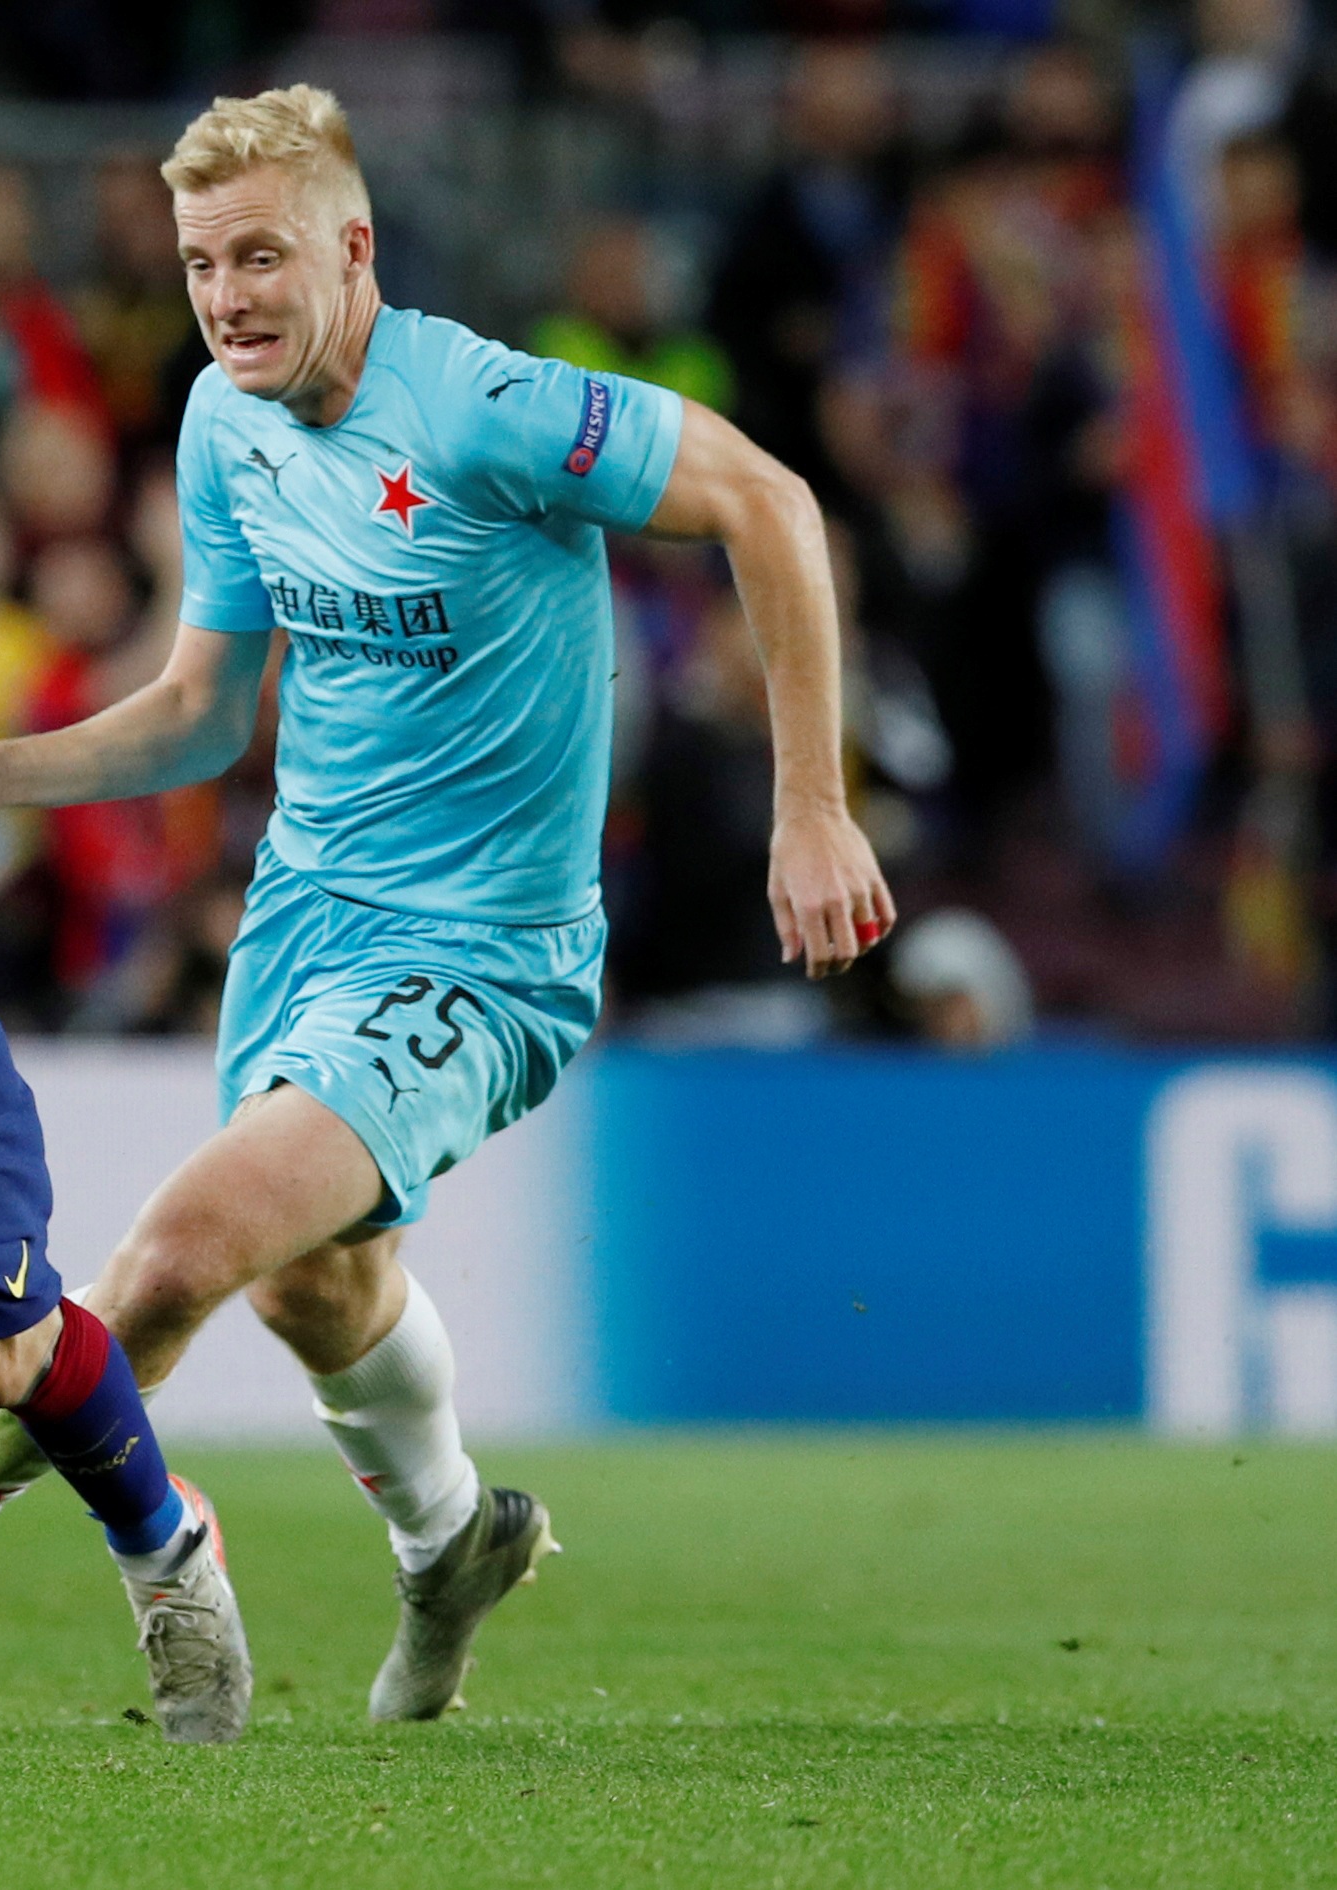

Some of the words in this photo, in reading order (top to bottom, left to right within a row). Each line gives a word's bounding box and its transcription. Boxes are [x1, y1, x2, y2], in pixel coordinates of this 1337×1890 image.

[583, 381, 606, 449] RESPECT
[269, 576, 450, 637] 中信集团
[361, 643, 458, 673] Group
[354, 975, 487, 1070] 25
